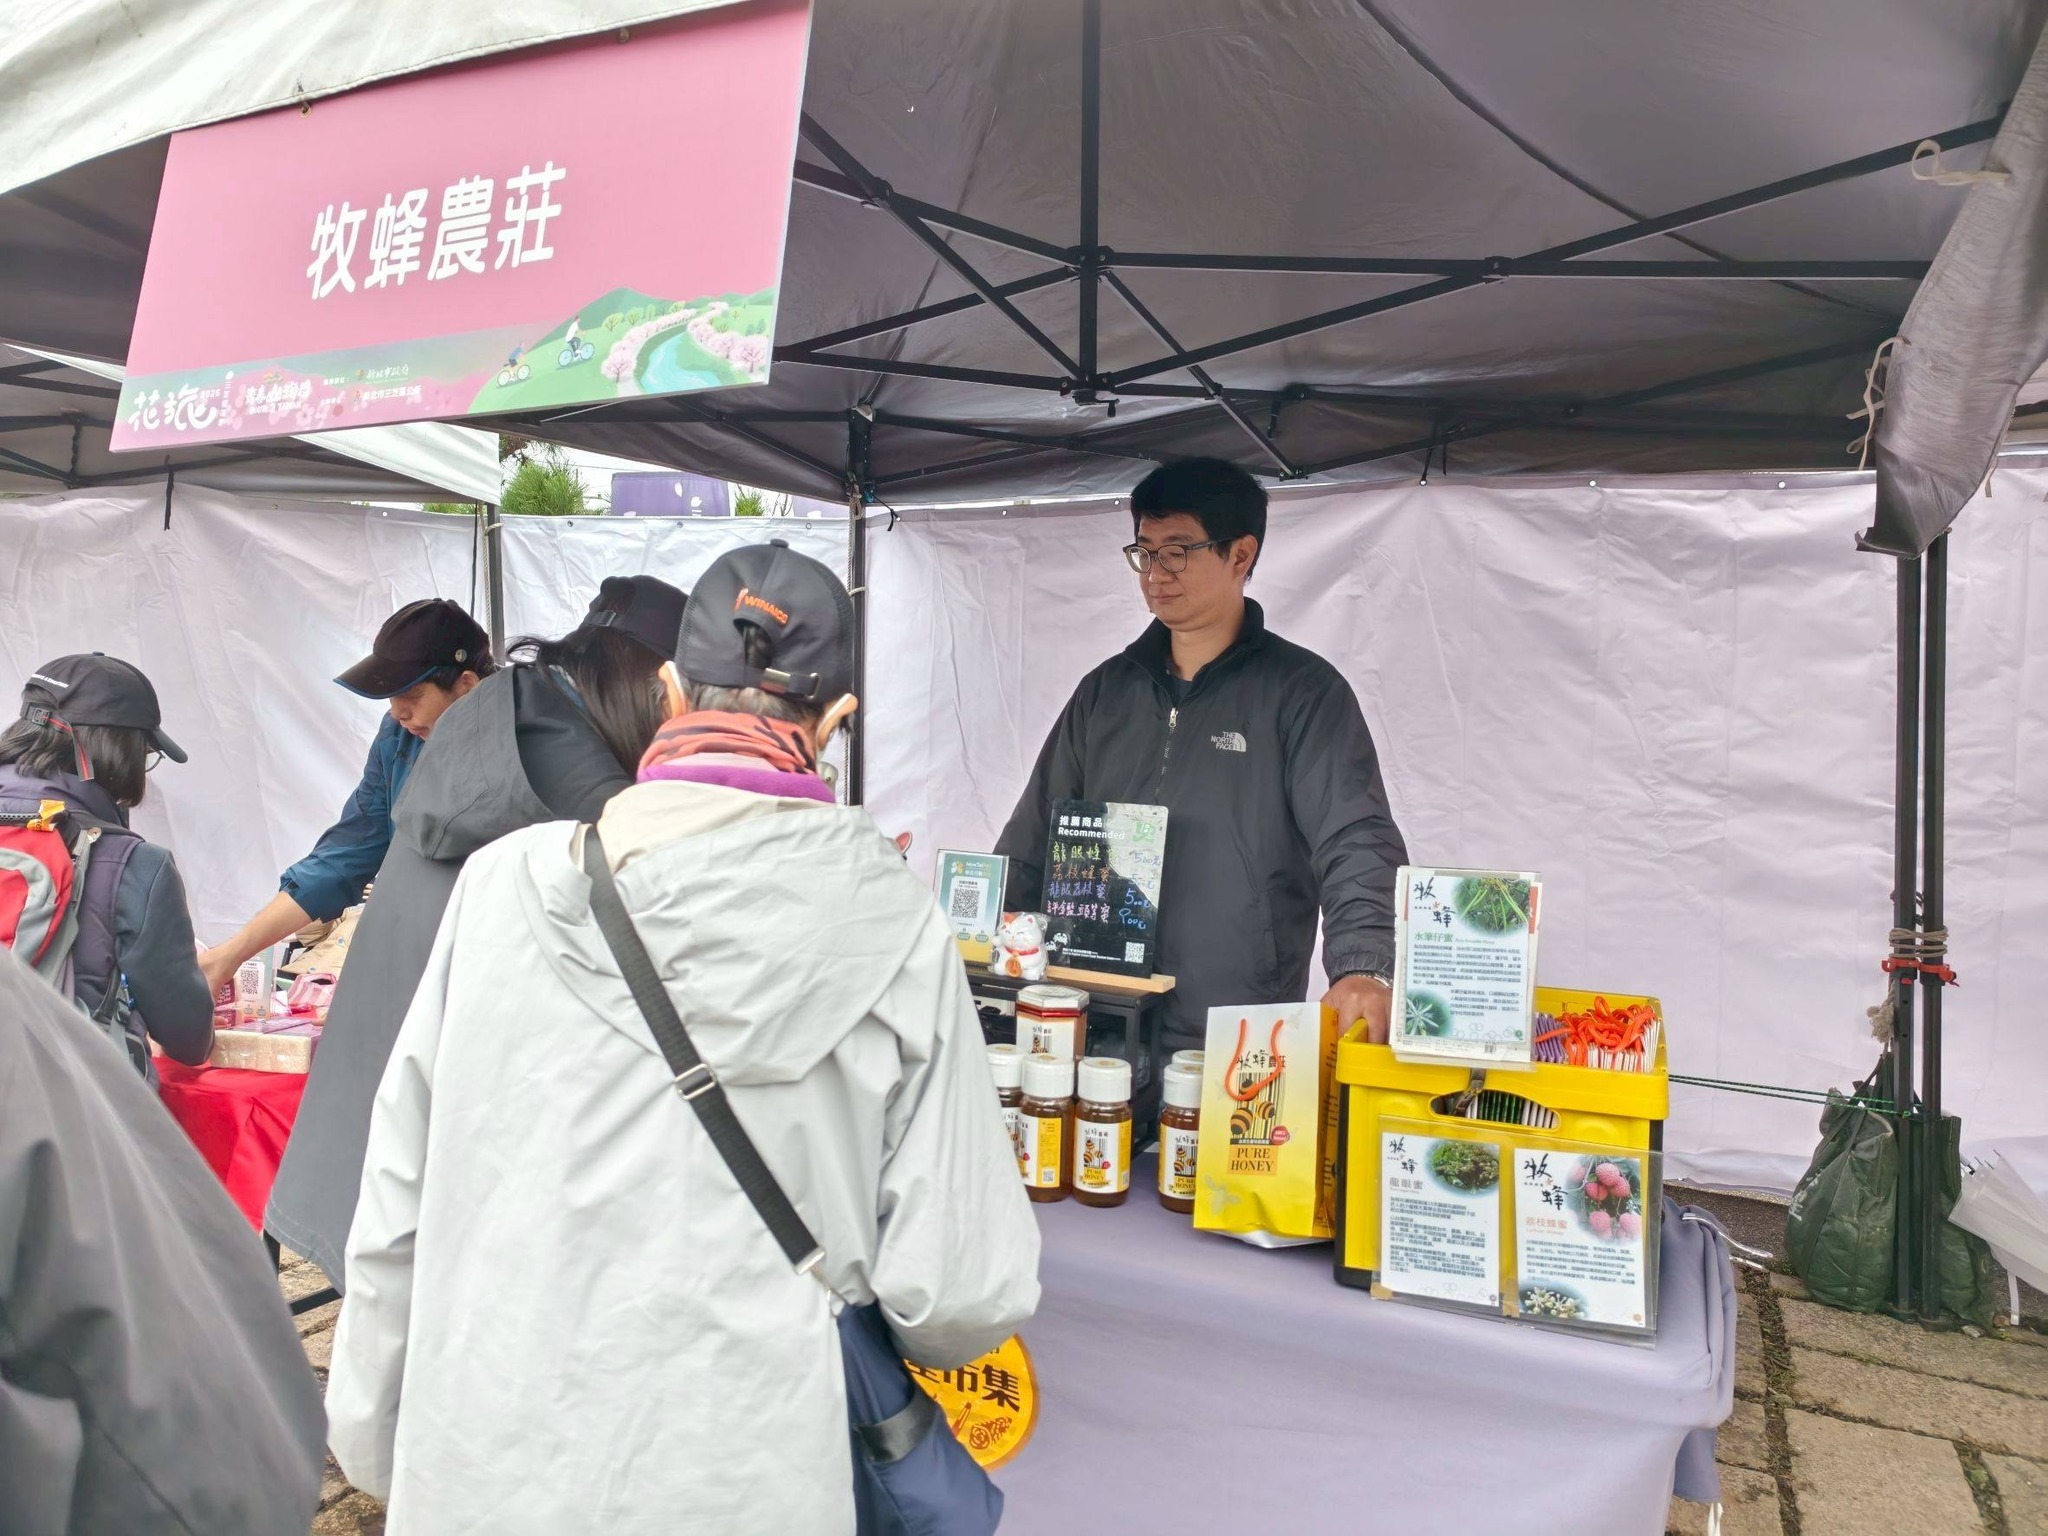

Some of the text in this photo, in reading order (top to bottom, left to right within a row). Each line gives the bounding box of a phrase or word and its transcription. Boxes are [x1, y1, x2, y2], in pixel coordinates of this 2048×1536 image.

[305, 160, 567, 301] 牧蜂農莊
[1210, 735, 1234, 745] NORTH
[1222, 731, 1237, 739] THE
[1215, 743, 1236, 751] FACE
[1059, 814, 1103, 828] 推薦商品
[1058, 827, 1126, 841] Recommended
[1237, 1147, 1271, 1159] PURE
[1231, 1160, 1275, 1172] HONEY
